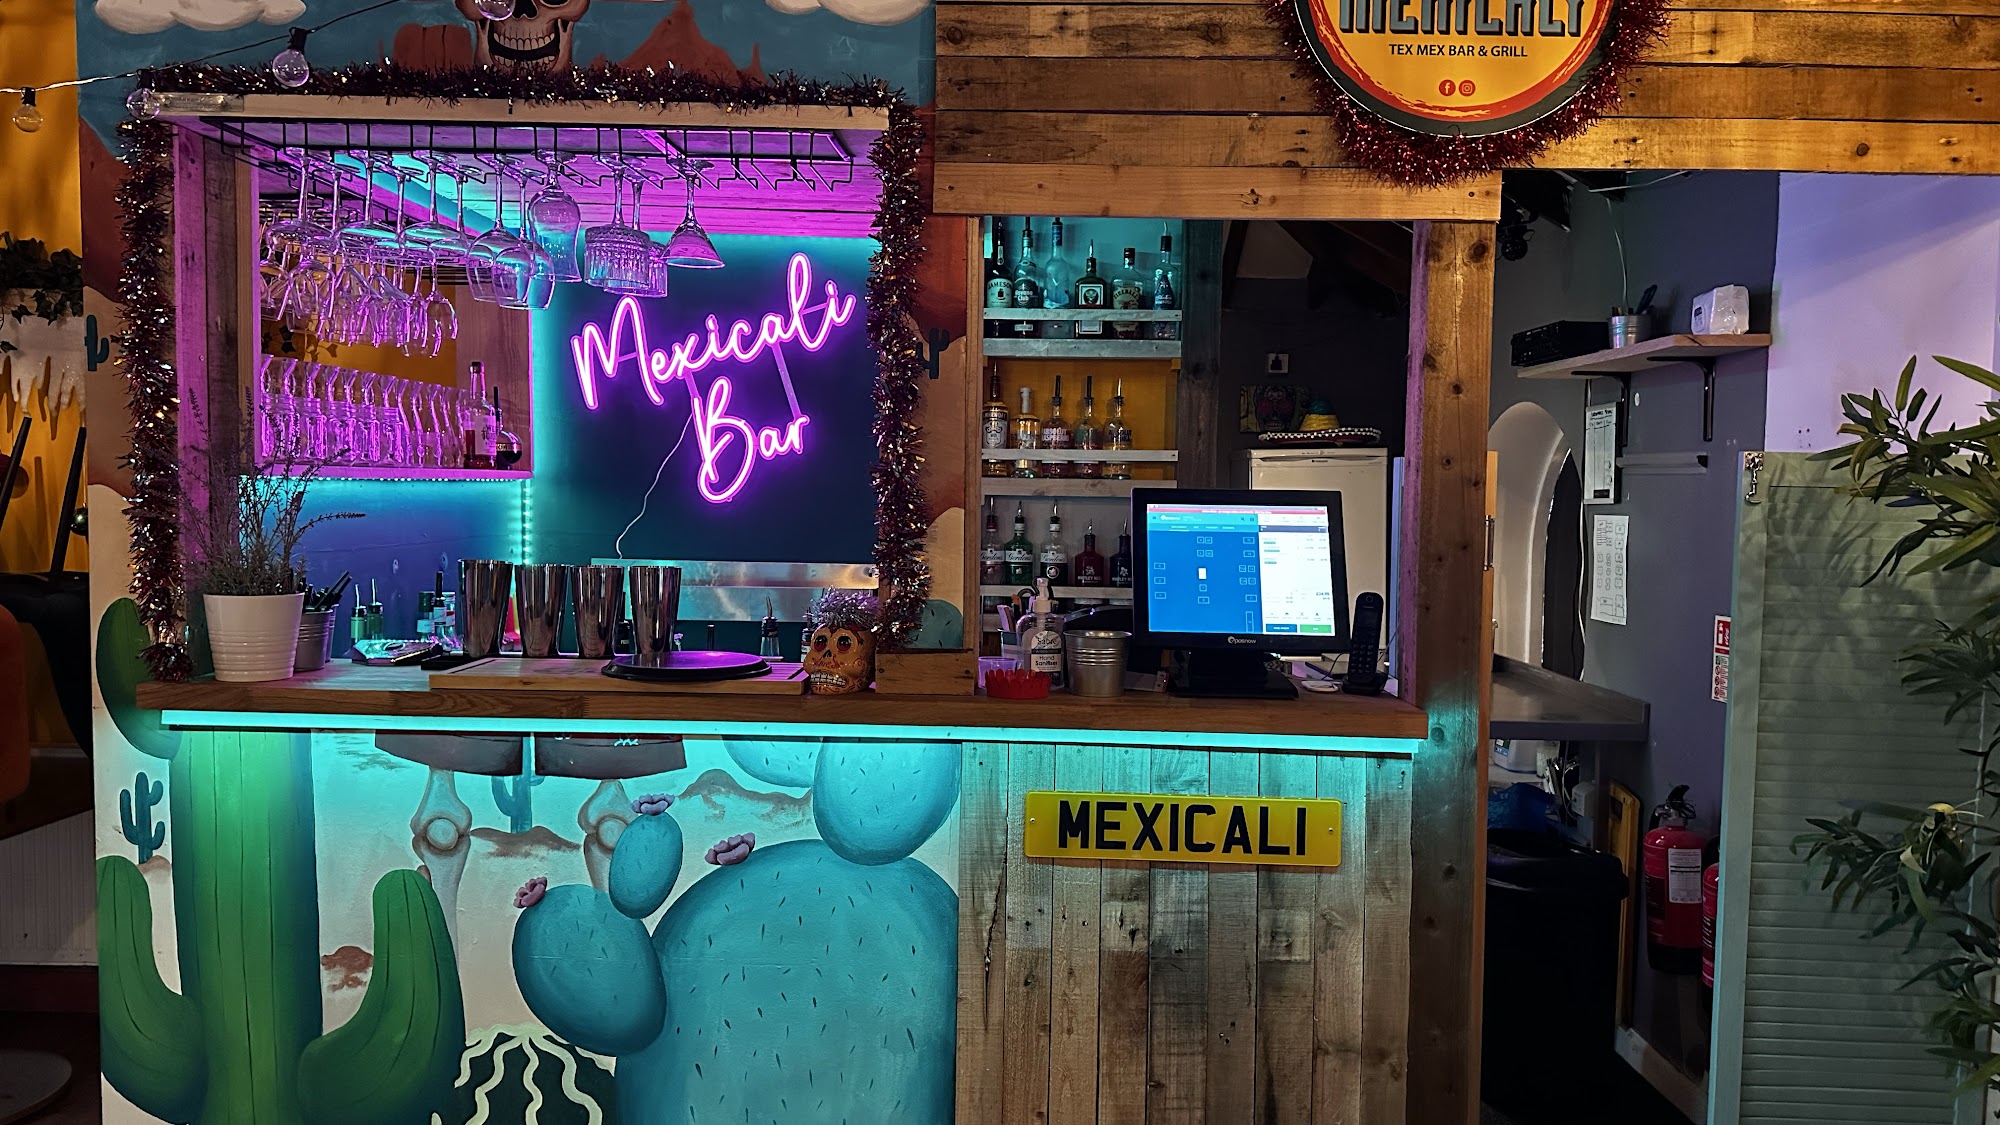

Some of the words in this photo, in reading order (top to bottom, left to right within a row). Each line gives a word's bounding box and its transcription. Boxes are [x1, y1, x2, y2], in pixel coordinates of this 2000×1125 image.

[1389, 43, 1413, 56] TEX
[1416, 44, 1446, 57] MEX
[1448, 44, 1475, 57] BAR
[1478, 45, 1488, 57] &
[1490, 45, 1528, 58] GRILL
[988, 281, 1012, 290] JAMESON
[571, 252, 857, 410] Mexicali
[691, 375, 811, 504] Bar
[1057, 799, 1307, 857] MEXICALI
